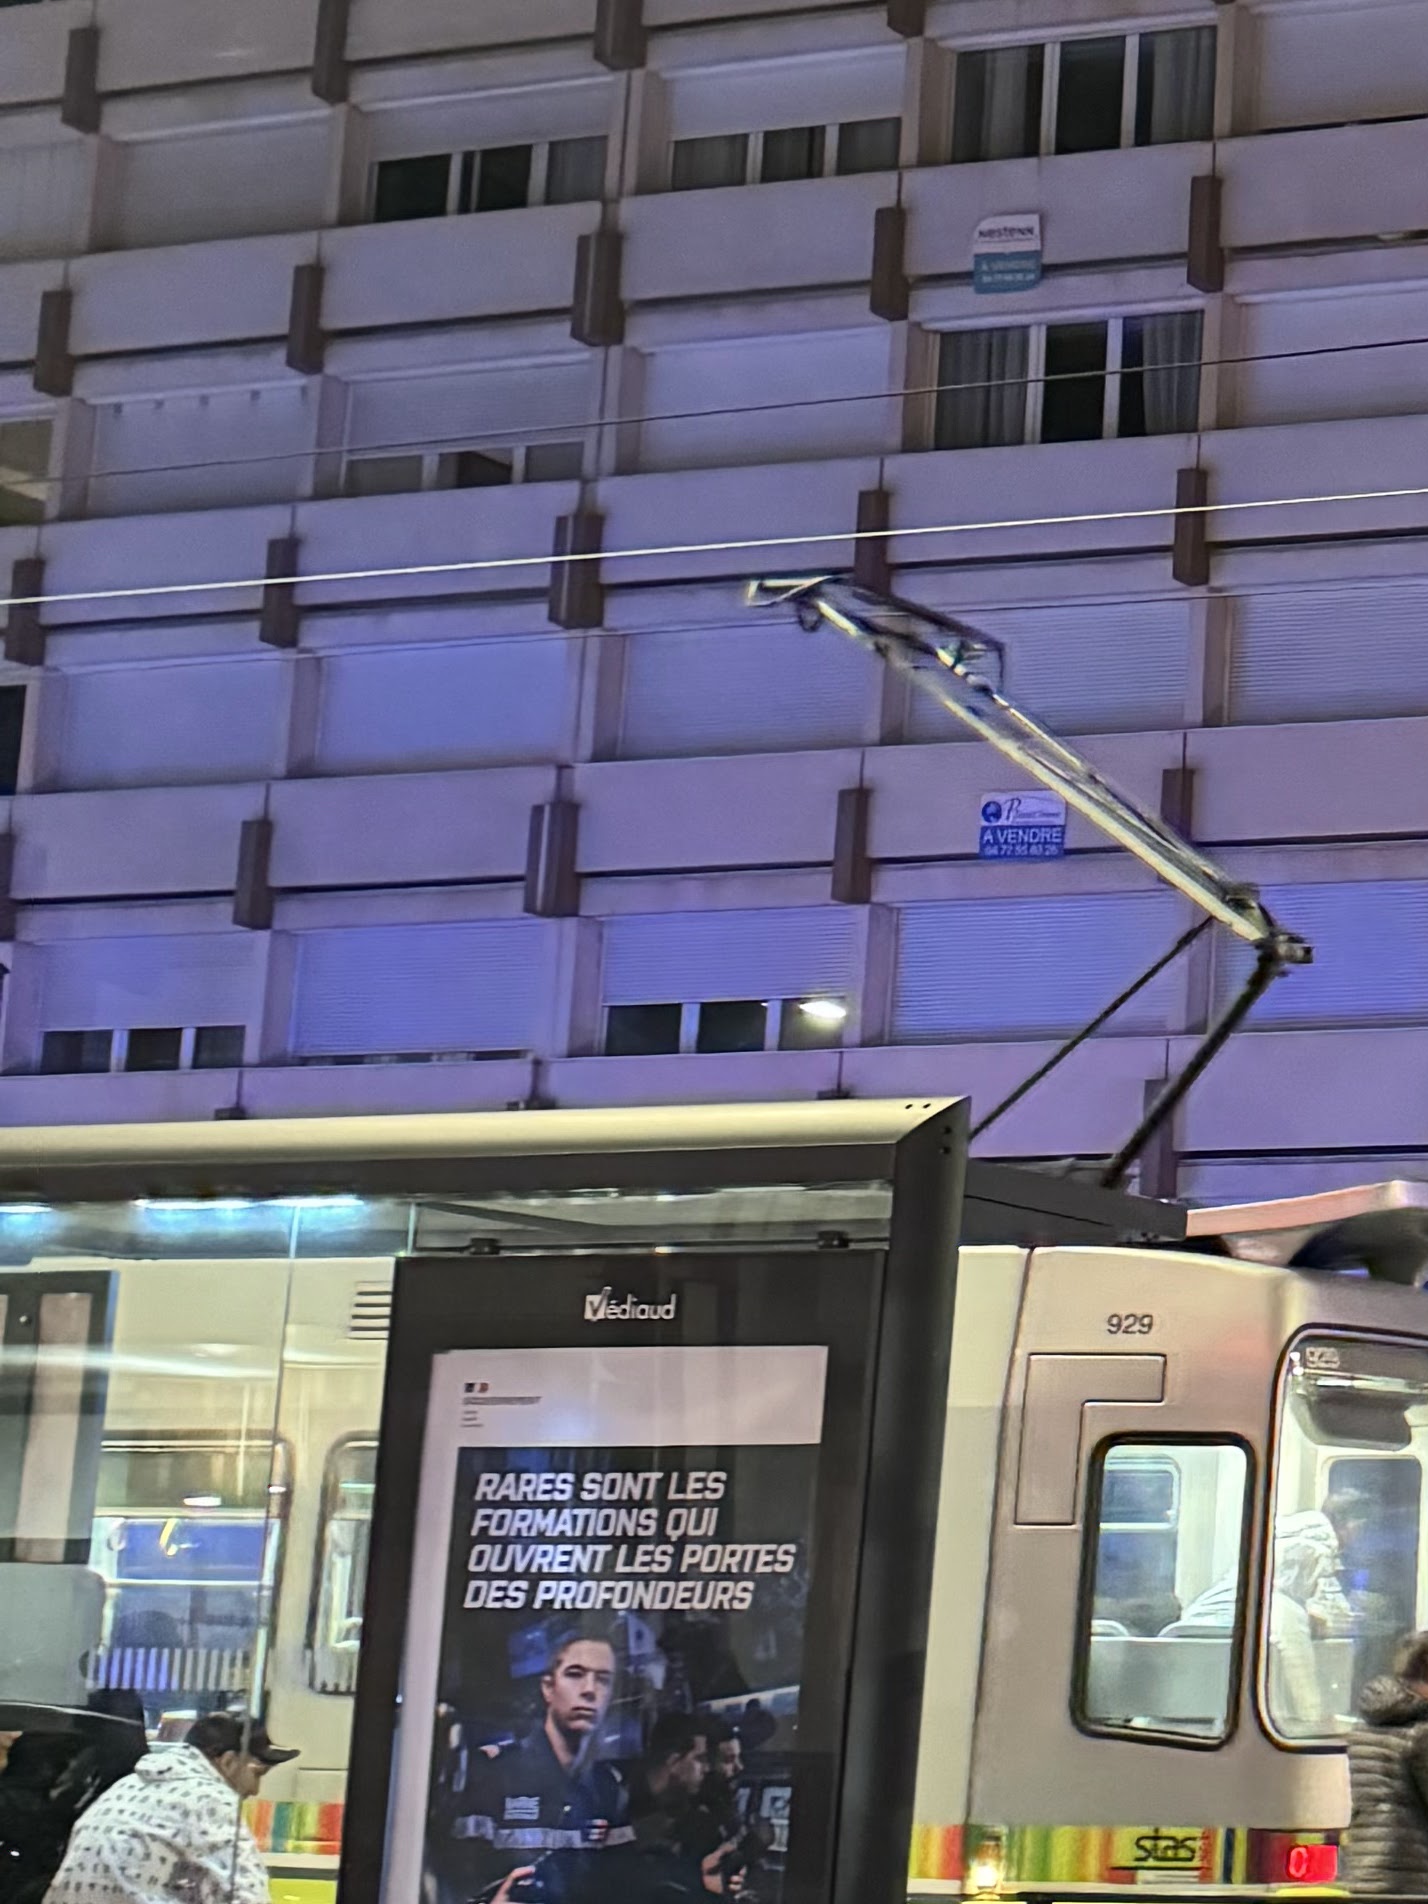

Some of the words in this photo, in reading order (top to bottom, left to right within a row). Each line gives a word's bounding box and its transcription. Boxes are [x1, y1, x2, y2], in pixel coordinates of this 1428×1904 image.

[996, 826, 1062, 845] VENDRE
[1107, 1313, 1154, 1335] 929
[475, 1472, 575, 1501] RARES
[580, 1472, 664, 1501] SONT
[667, 1471, 727, 1500] LES
[470, 1508, 659, 1537] FORMATIONS
[665, 1507, 719, 1542] QUI
[467, 1544, 613, 1573] OUVRENT
[615, 1544, 675, 1573] LES
[680, 1543, 797, 1573] PORTES
[463, 1580, 529, 1609] DES
[532, 1580, 755, 1610] PROFONDEURS
